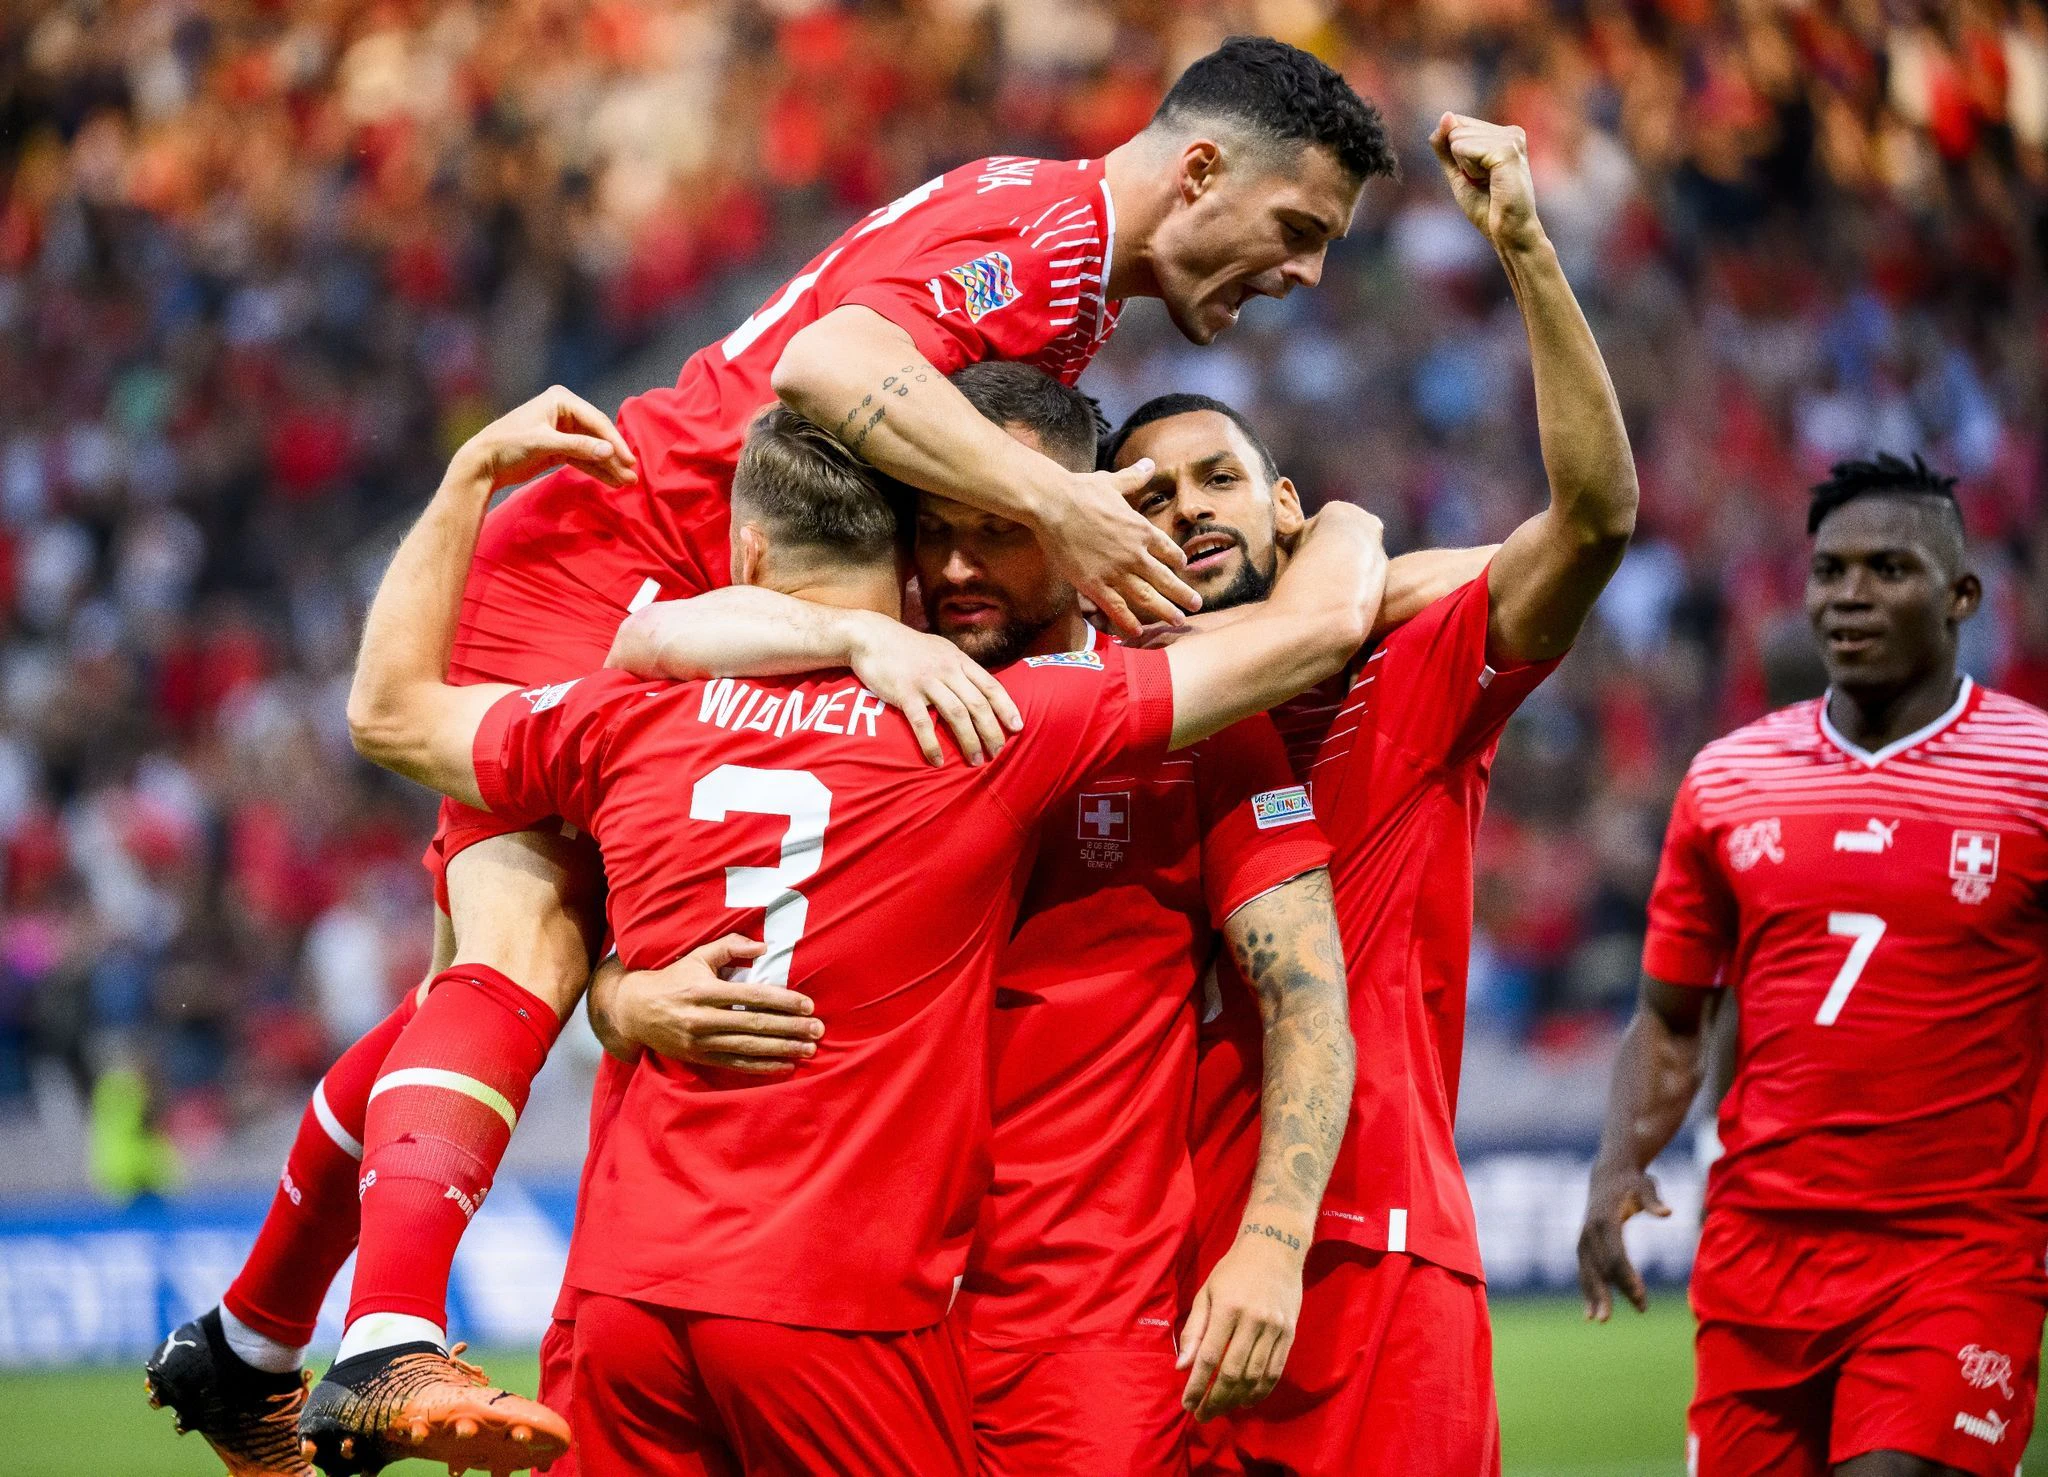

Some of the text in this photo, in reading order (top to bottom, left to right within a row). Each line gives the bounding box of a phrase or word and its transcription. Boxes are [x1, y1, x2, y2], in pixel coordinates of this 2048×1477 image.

[1254, 793, 1276, 804] UEFA
[689, 764, 833, 988] 3
[1080, 848, 1096, 860] SUI
[1104, 850, 1124, 863] POR
[1814, 910, 1887, 1026] 7
